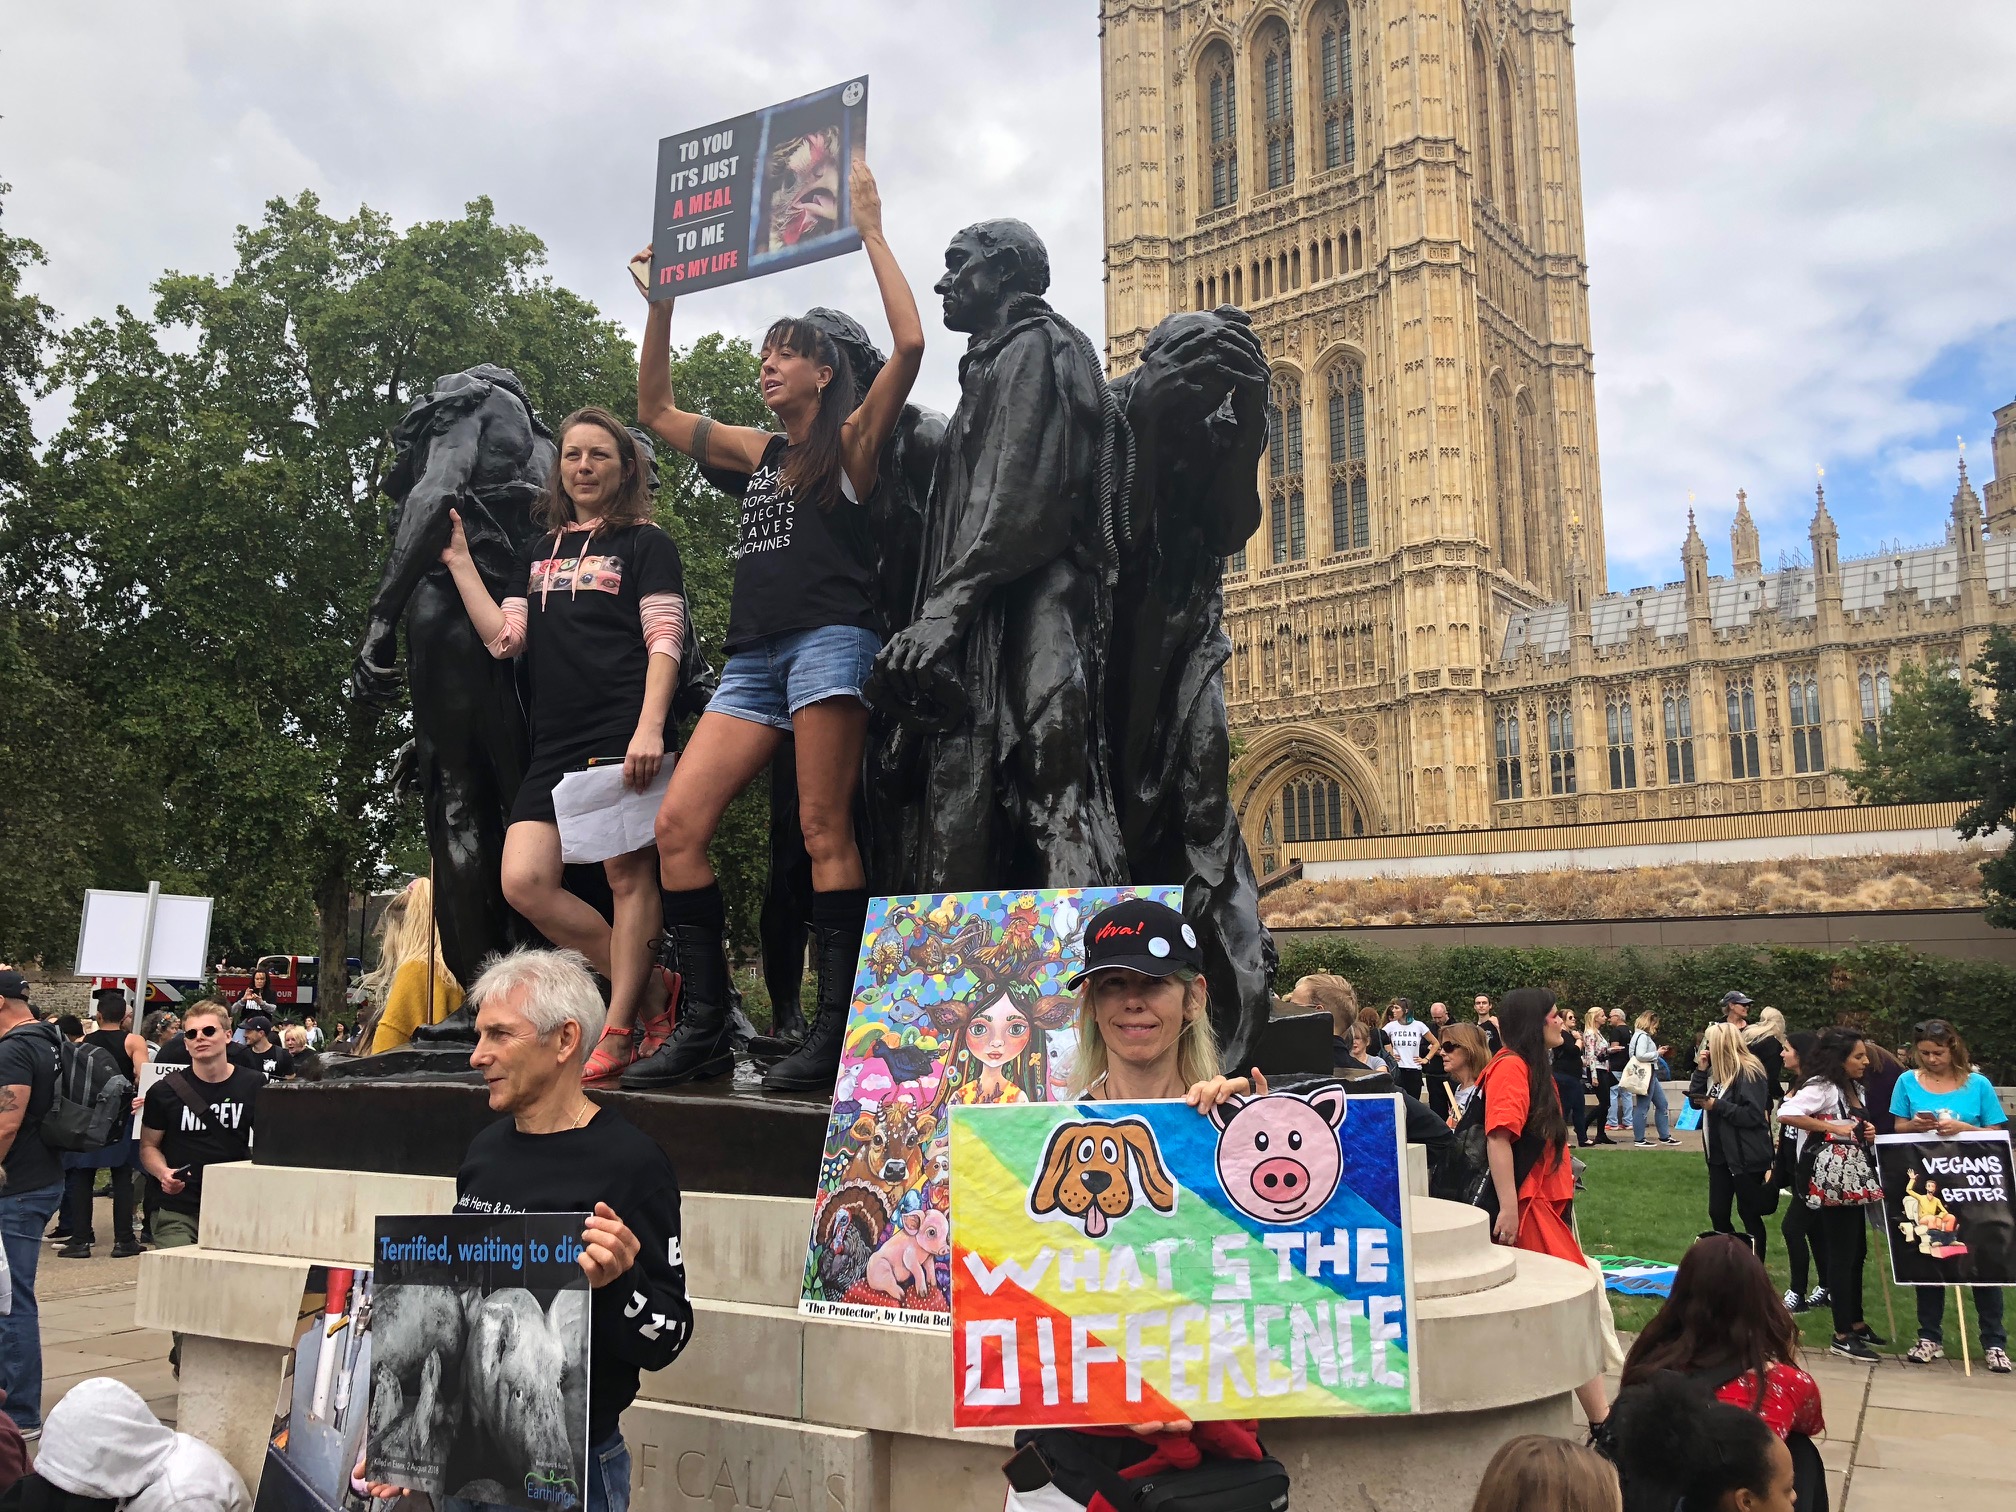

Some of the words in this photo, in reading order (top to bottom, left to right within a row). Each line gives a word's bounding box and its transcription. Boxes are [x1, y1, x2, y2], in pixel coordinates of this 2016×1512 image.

[679, 141, 698, 163] TO
[702, 129, 734, 157] YOU
[670, 167, 698, 193] IT'S
[701, 156, 739, 184] JUST
[673, 199, 684, 219] A
[689, 186, 732, 215] MEAL
[677, 230, 697, 253] TO
[701, 223, 725, 247] ME
[660, 264, 684, 285] IT'S
[688, 258, 709, 279] MY
[711, 250, 738, 273] LIFE
[742, 501, 795, 525] BJECTS
[747, 517, 794, 539] AVES
[1095, 920, 1145, 944] Viva!
[1921, 1155, 2003, 1174] VEGANS
[1941, 1187, 2008, 1202] BETTER
[1966, 1174, 1986, 1186] DO
[1988, 1174, 2004, 1186] IT
[470, 1196, 492, 1213] Herts
[493, 1202, 501, 1214] &
[380, 1234, 452, 1265] Terrified,
[458, 1236, 523, 1270] waiting
[529, 1239, 549, 1263] to
[555, 1235, 584, 1263] die
[1262, 1228, 1390, 1283] THE
[884, 1309, 896, 1322] by
[899, 1311, 930, 1325] Lynda
[963, 1295, 1405, 1407] DIFFERENCE
[527, 1481, 577, 1509] Earthlings
[676, 1449, 848, 1512] CALAIS
